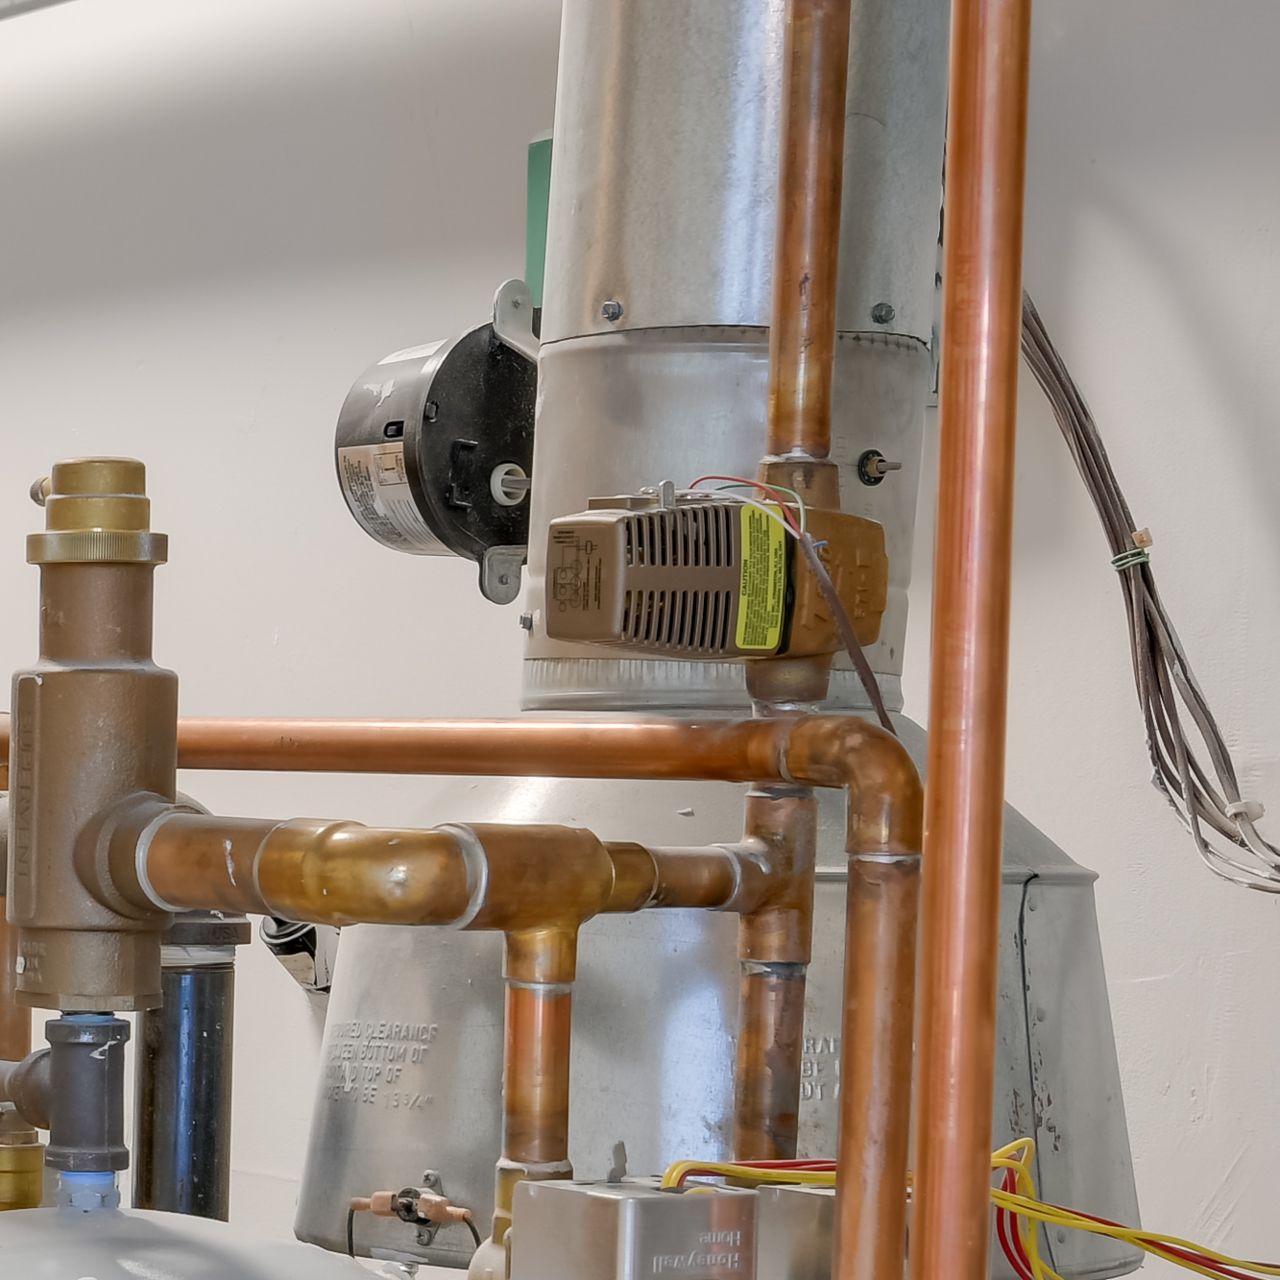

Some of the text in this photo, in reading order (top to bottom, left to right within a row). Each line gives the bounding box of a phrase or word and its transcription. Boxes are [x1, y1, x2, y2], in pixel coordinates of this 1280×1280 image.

[362, 1063, 382, 1082] TOP
[386, 1065, 402, 1084] OF
[699, 1231, 741, 1247] Home
[652, 1251, 740, 1273] Honeywell
